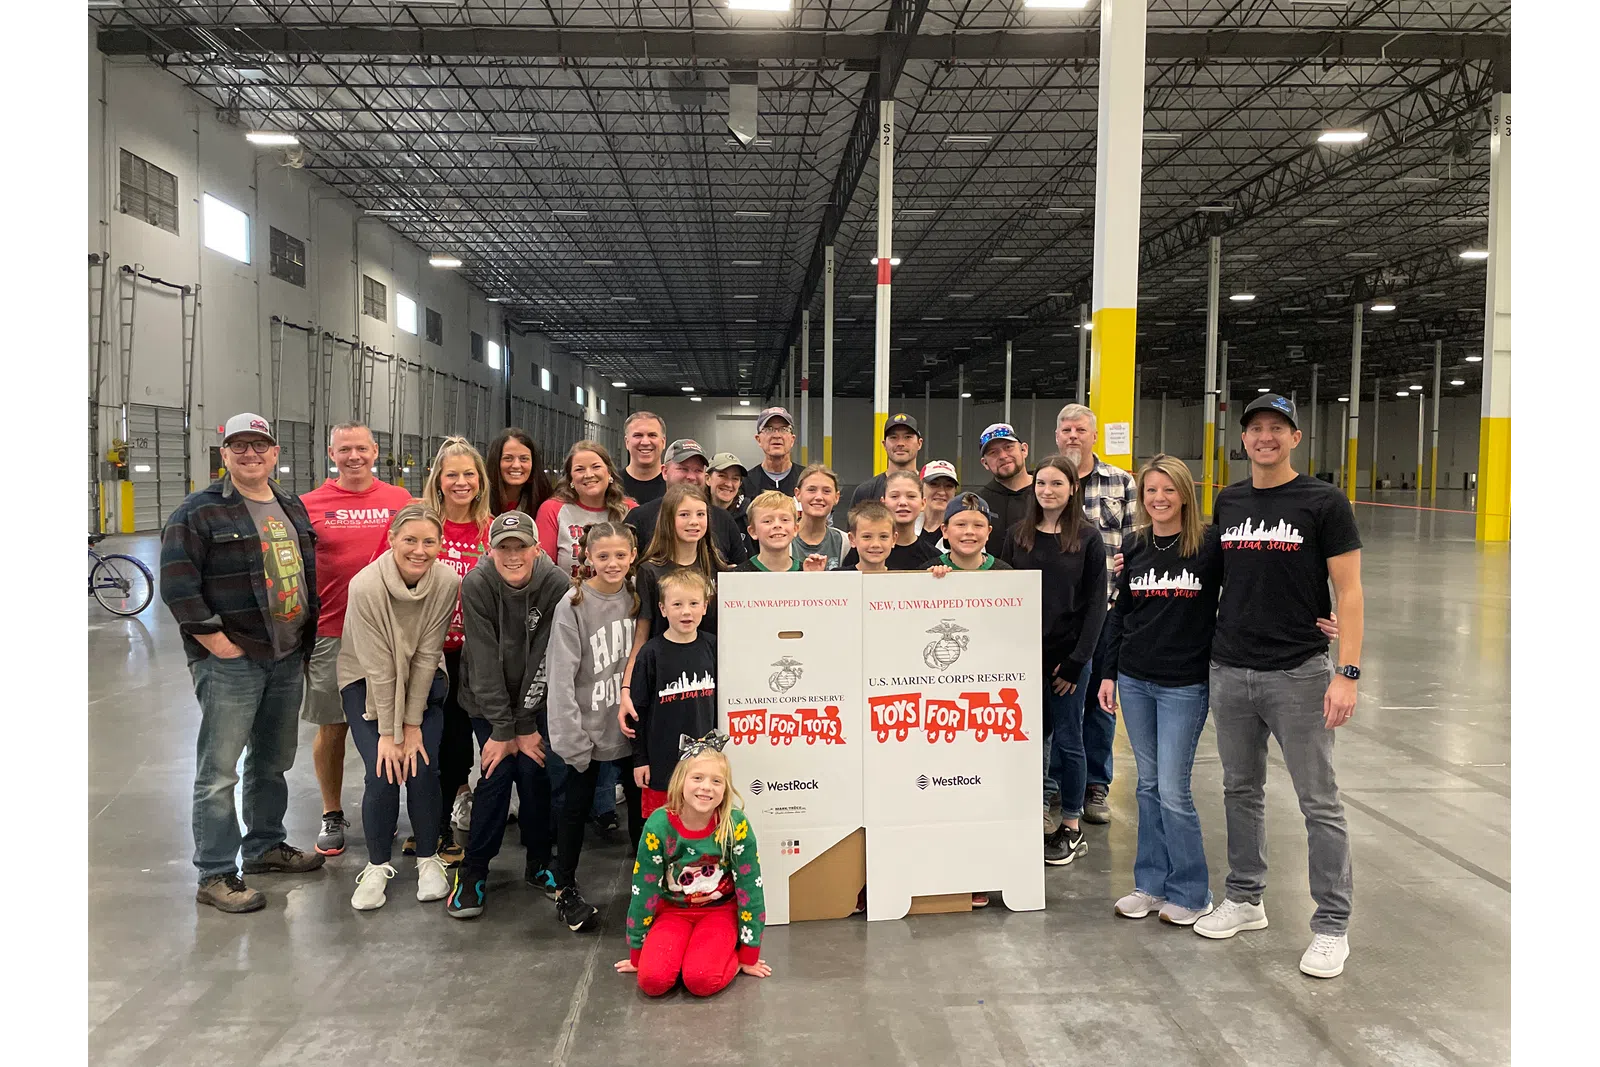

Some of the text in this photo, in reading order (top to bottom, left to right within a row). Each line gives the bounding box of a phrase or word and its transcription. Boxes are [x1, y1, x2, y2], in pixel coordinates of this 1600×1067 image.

[136, 437, 148, 449] 126
[335, 508, 389, 520] SWIM
[1237, 539, 1262, 551] Lead
[1145, 587, 1169, 598] Lead
[724, 598, 849, 609] NEW, UNWRAPPED TOYS ONLY
[869, 597, 1024, 611] NEW, UNWRAPPED TOYS ONLY
[868, 672, 1027, 687] U.S. MARINE CORPS RESERVE
[680, 690, 699, 700] Lead
[744, 696, 778, 705] MARINE
[779, 695, 807, 704] CORPS
[808, 694, 845, 703] RESERVE
[873, 699, 1016, 730] TOYS FOR TOTS
[731, 713, 837, 736] TOYS FOR TOTS
[767, 779, 819, 791] WestRock
[932, 775, 982, 786] WestRock
